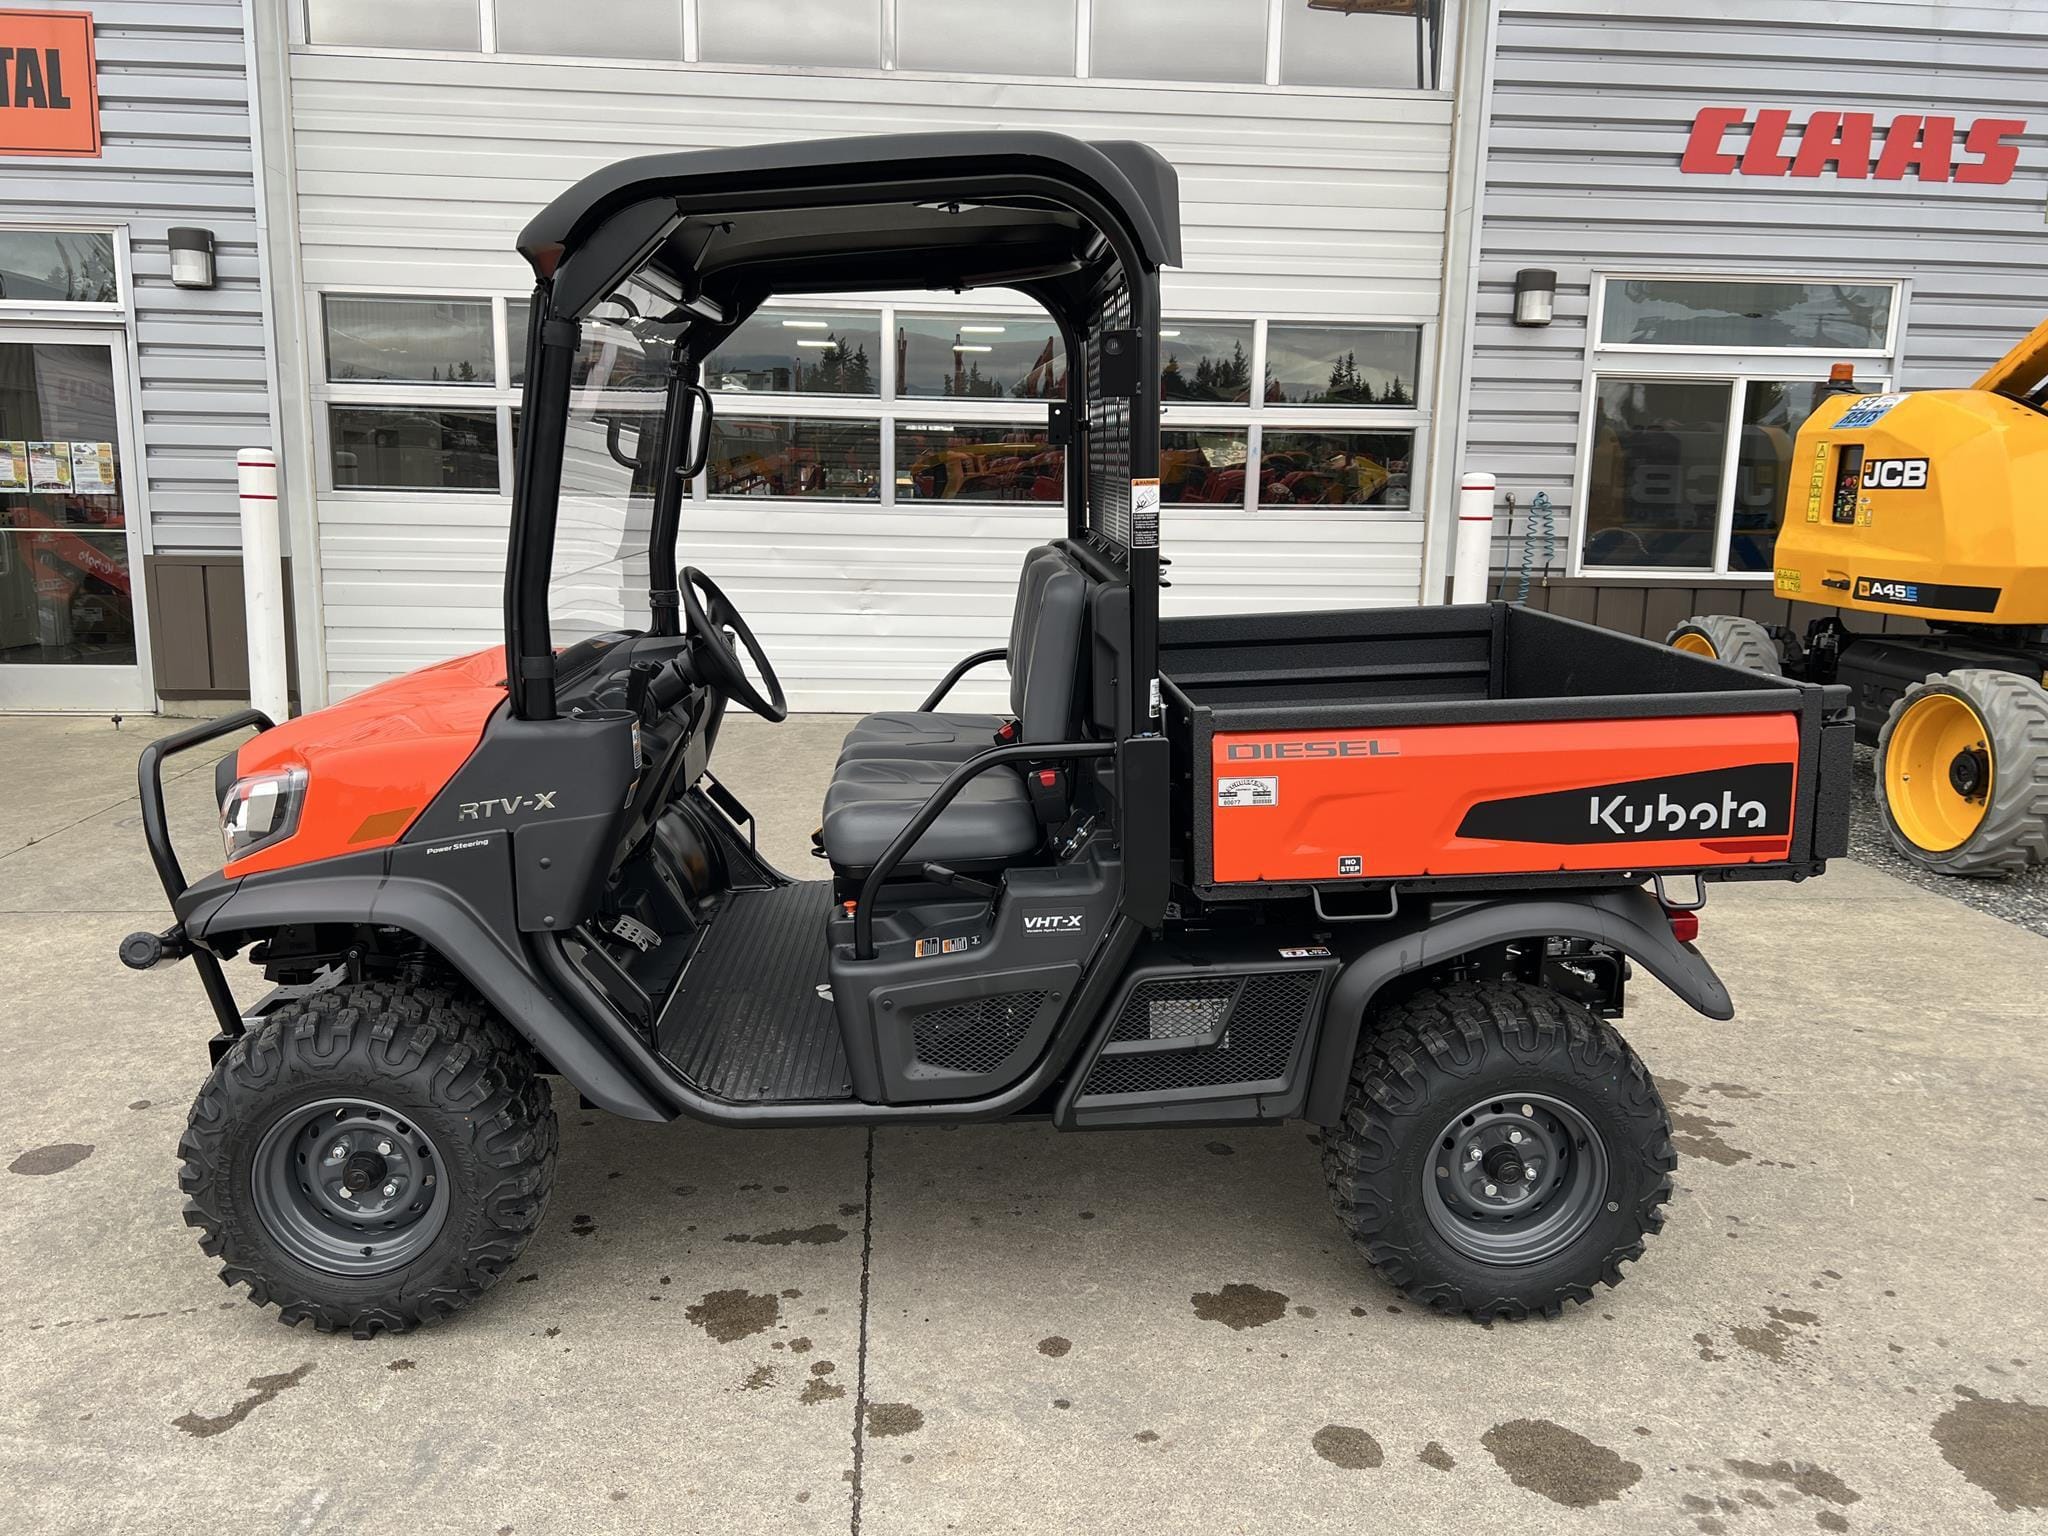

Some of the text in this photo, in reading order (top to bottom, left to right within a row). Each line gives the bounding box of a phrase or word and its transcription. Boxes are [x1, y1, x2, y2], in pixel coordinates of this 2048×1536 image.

[1680, 107, 2028, 184] CLAAS
[1863, 460, 1928, 488] JCB
[1870, 582, 1918, 600] A45E
[1228, 740, 1400, 760] DIESEL
[458, 791, 557, 822] RTV-X
[1590, 791, 1766, 834] Kubota
[426, 839, 489, 855] Power Steering
[1024, 915, 1083, 928] VHT-X
